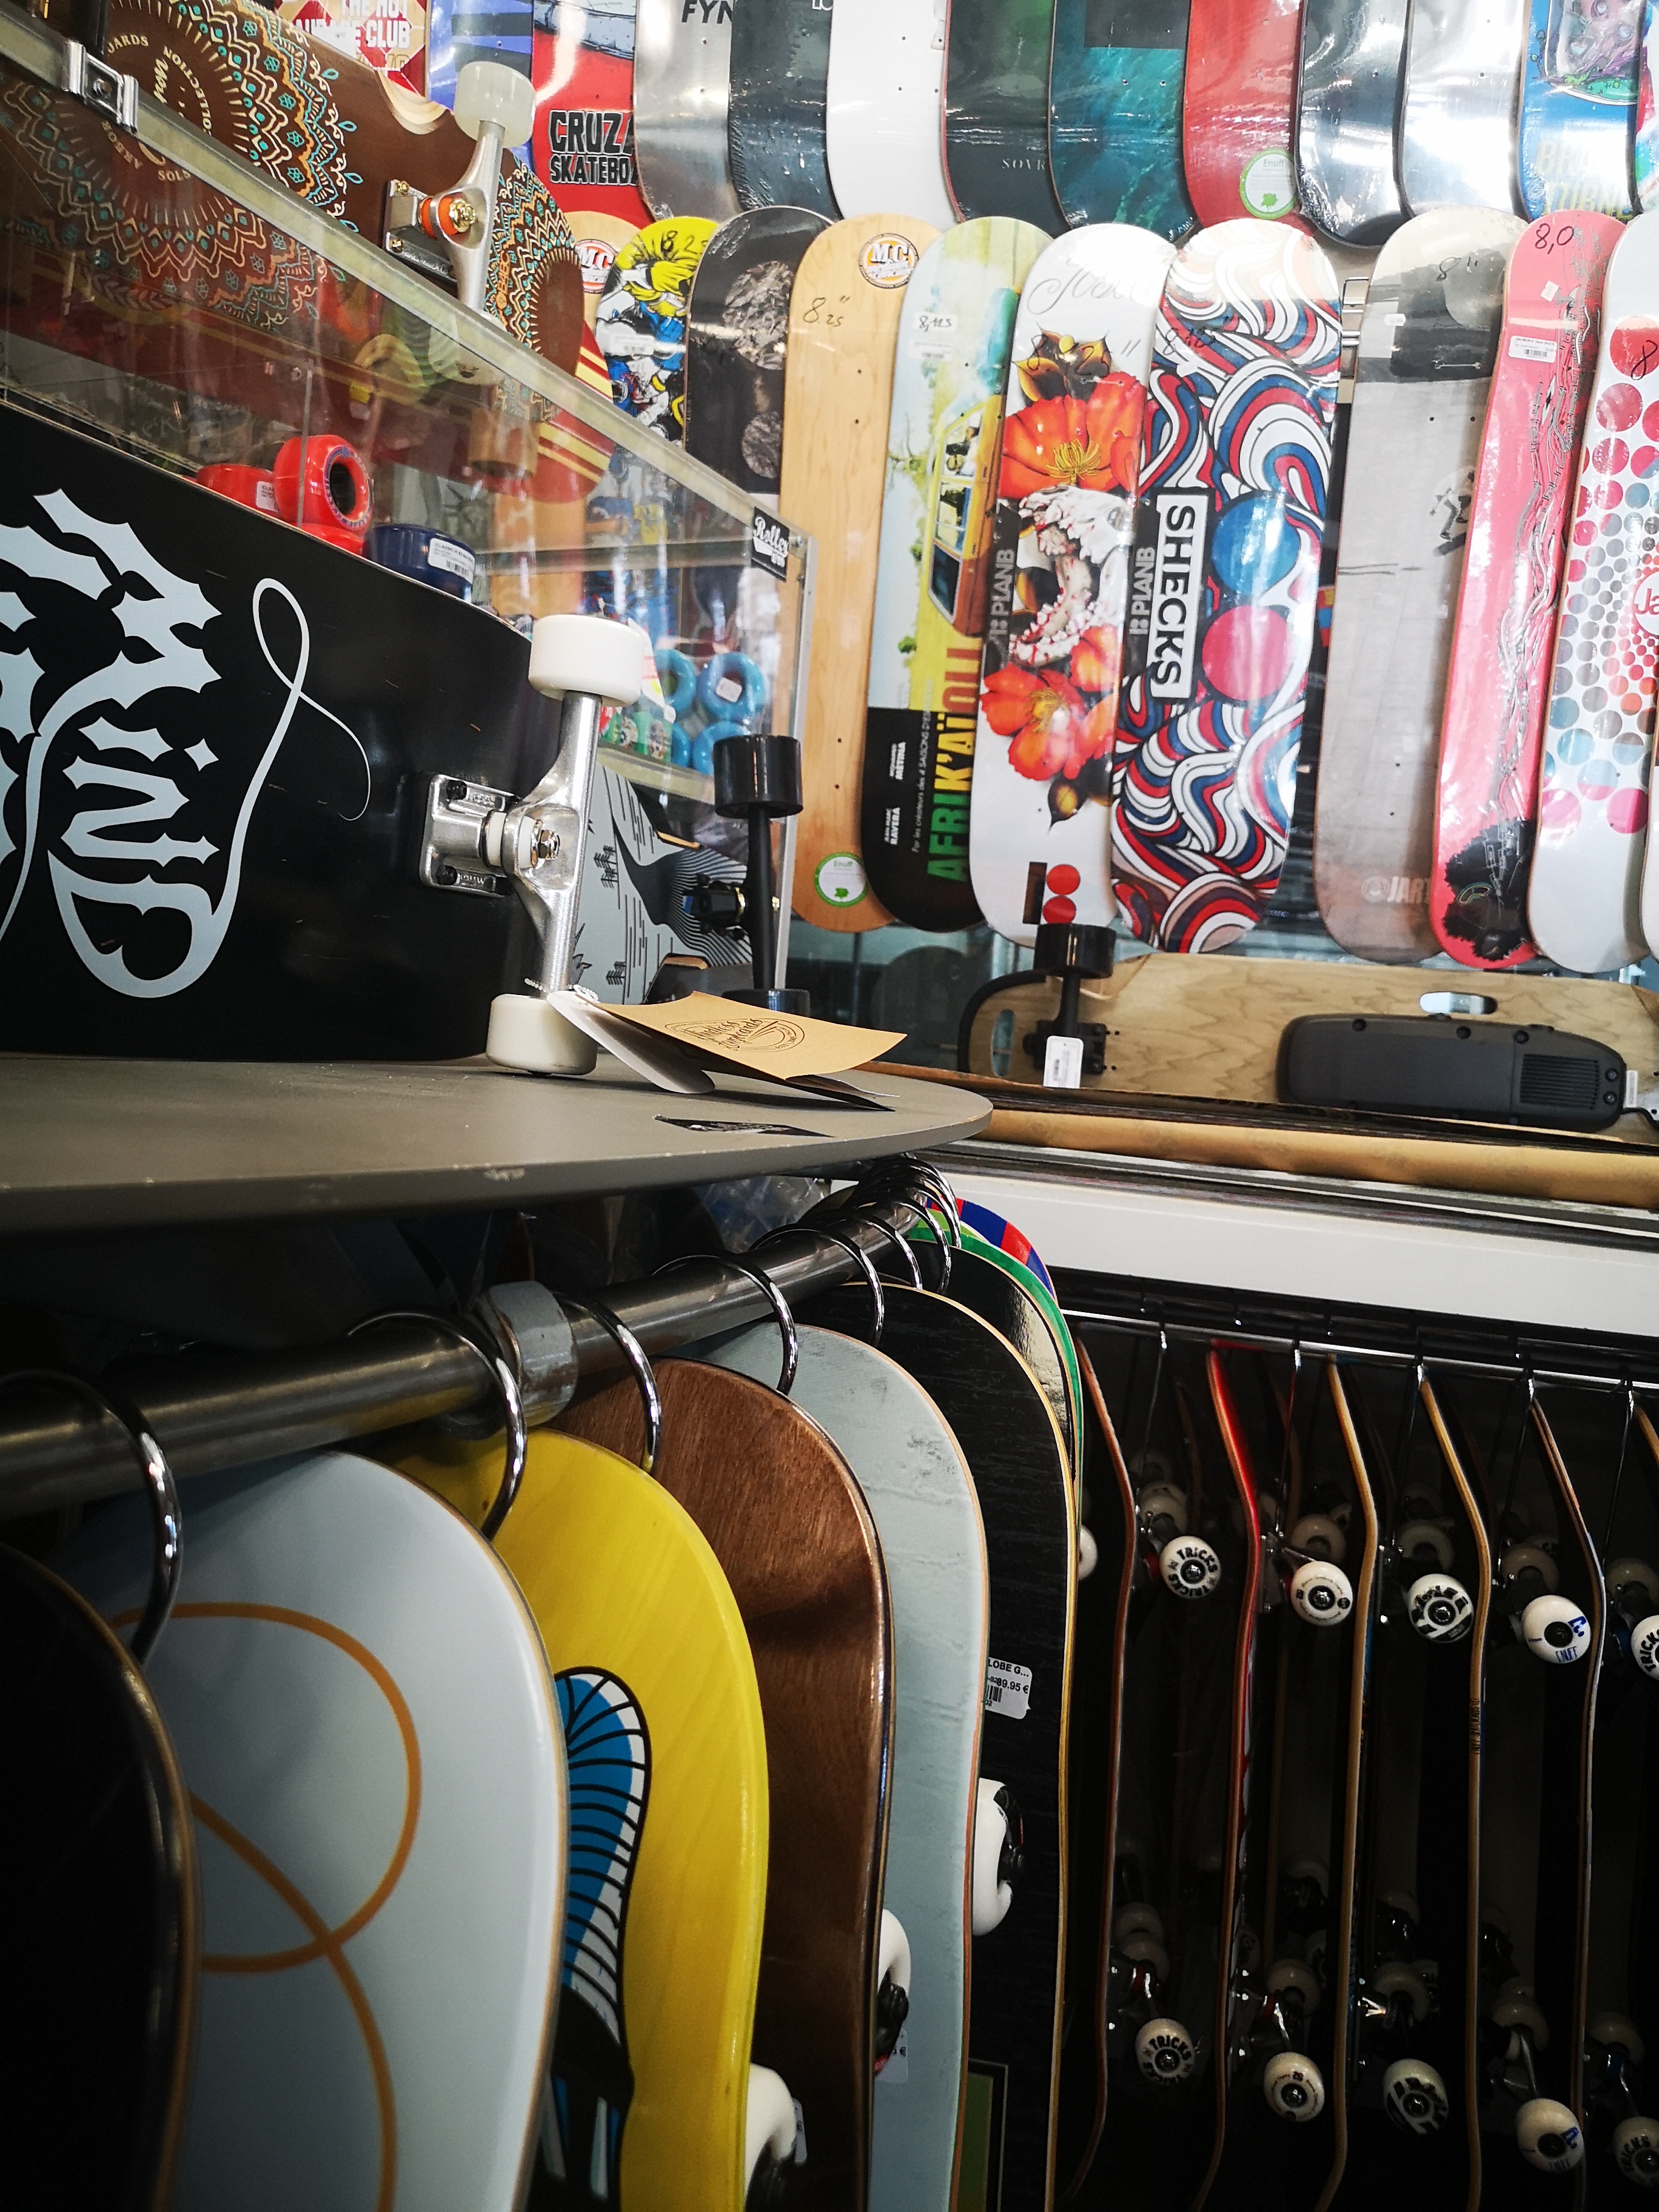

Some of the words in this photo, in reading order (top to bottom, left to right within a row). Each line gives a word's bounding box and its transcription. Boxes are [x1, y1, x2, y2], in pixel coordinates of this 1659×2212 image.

[365, 19, 411, 49] CLUB
[163, 44, 213, 136] OLLECTION
[1153, 504, 1196, 686] SHECKS
[1022, 1685, 1030, 1694] €
